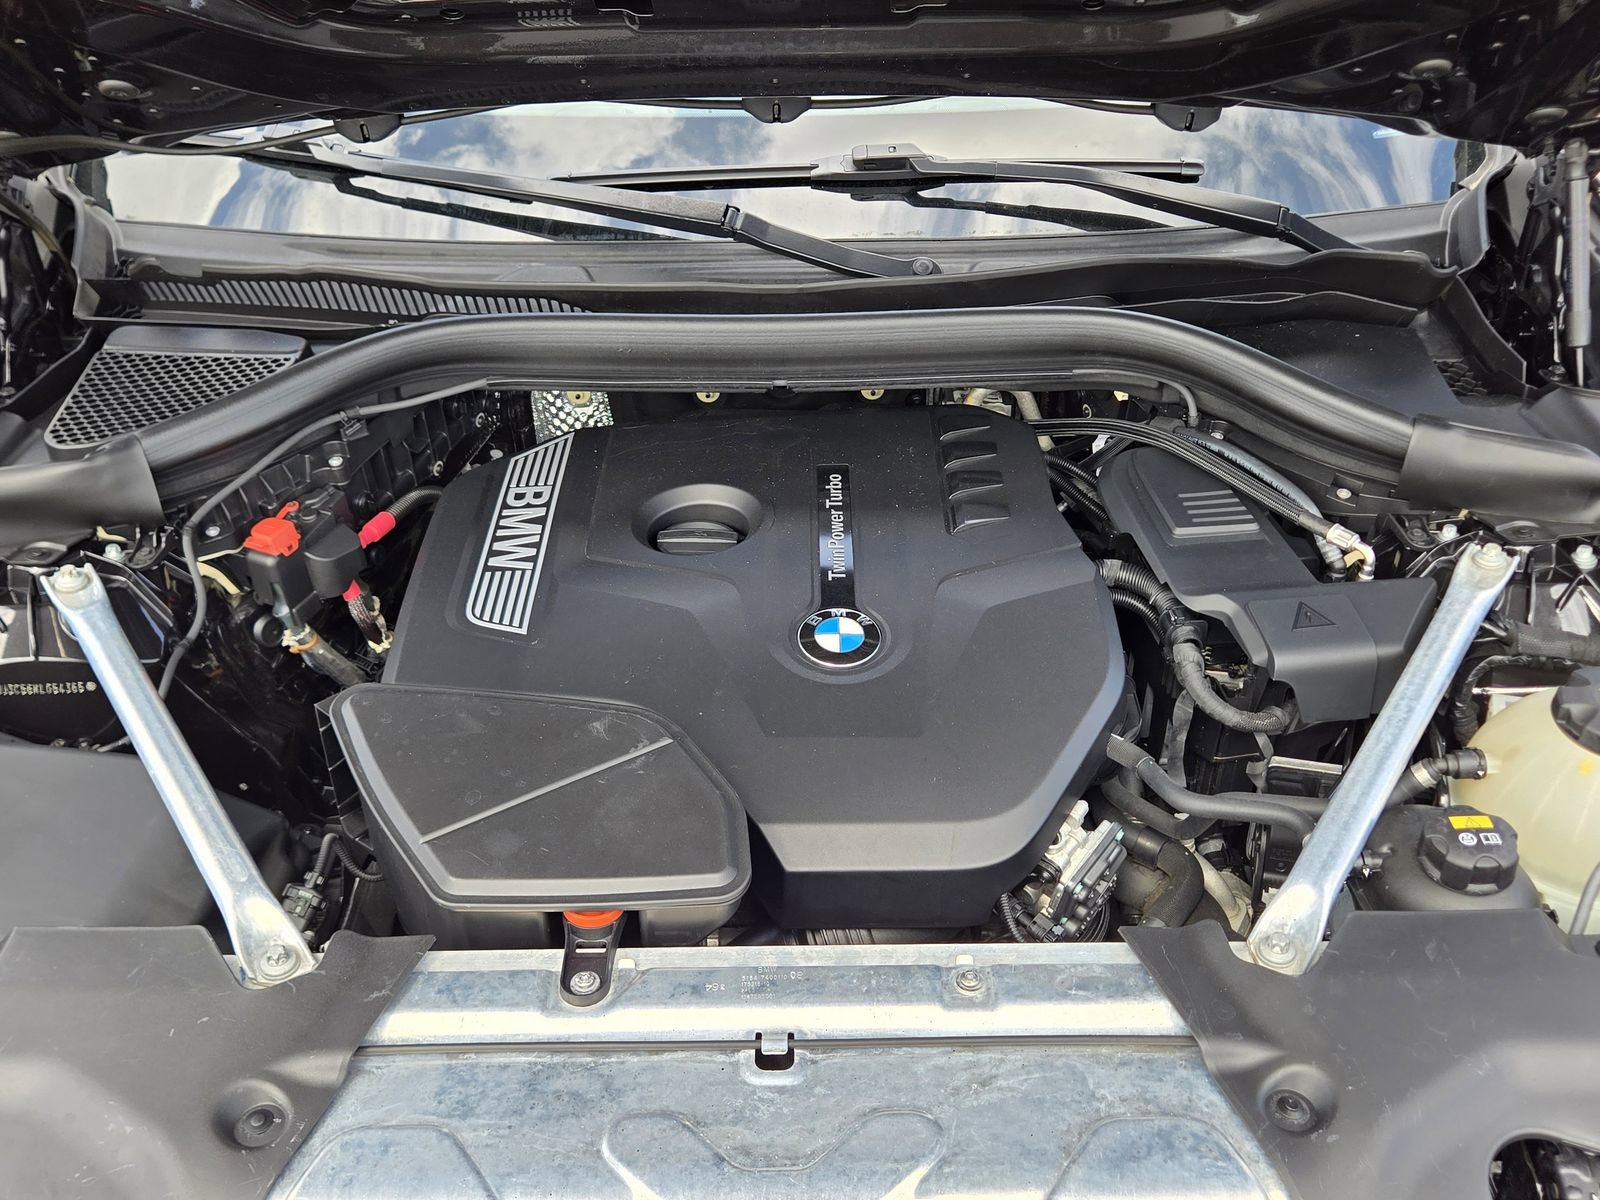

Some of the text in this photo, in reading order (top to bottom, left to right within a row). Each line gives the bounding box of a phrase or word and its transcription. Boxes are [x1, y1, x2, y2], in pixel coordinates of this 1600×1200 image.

[487, 484, 553, 570] BMW
[825, 473, 847, 582] TwinPower Turbo
